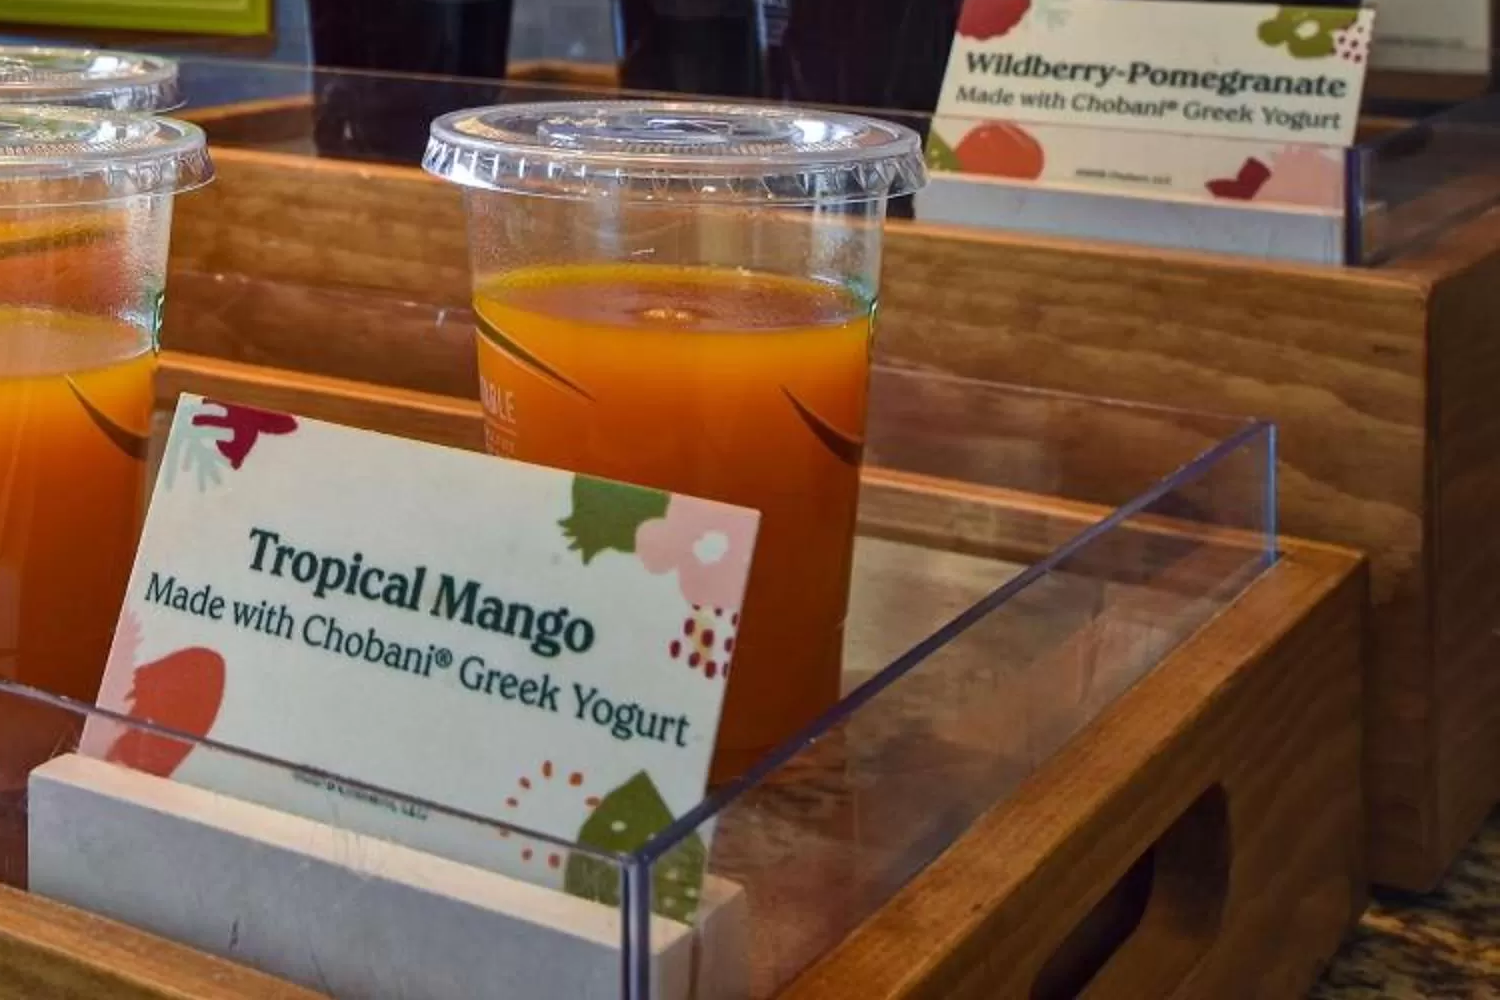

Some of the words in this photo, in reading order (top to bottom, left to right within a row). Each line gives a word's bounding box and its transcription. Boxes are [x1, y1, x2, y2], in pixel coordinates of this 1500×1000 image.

[955, 85, 1015, 107] Made
[1019, 90, 1066, 112] with
[1182, 99, 1255, 124] Greek
[1261, 107, 1343, 132] Yogurt
[965, 50, 1348, 98] Wildberry-Pomegranate
[248, 527, 426, 613] Tropical
[431, 574, 595, 659] Mango
[145, 570, 227, 619] Made
[231, 600, 295, 639] with
[459, 656, 560, 711] Greek
[573, 683, 690, 748] Yogurt
